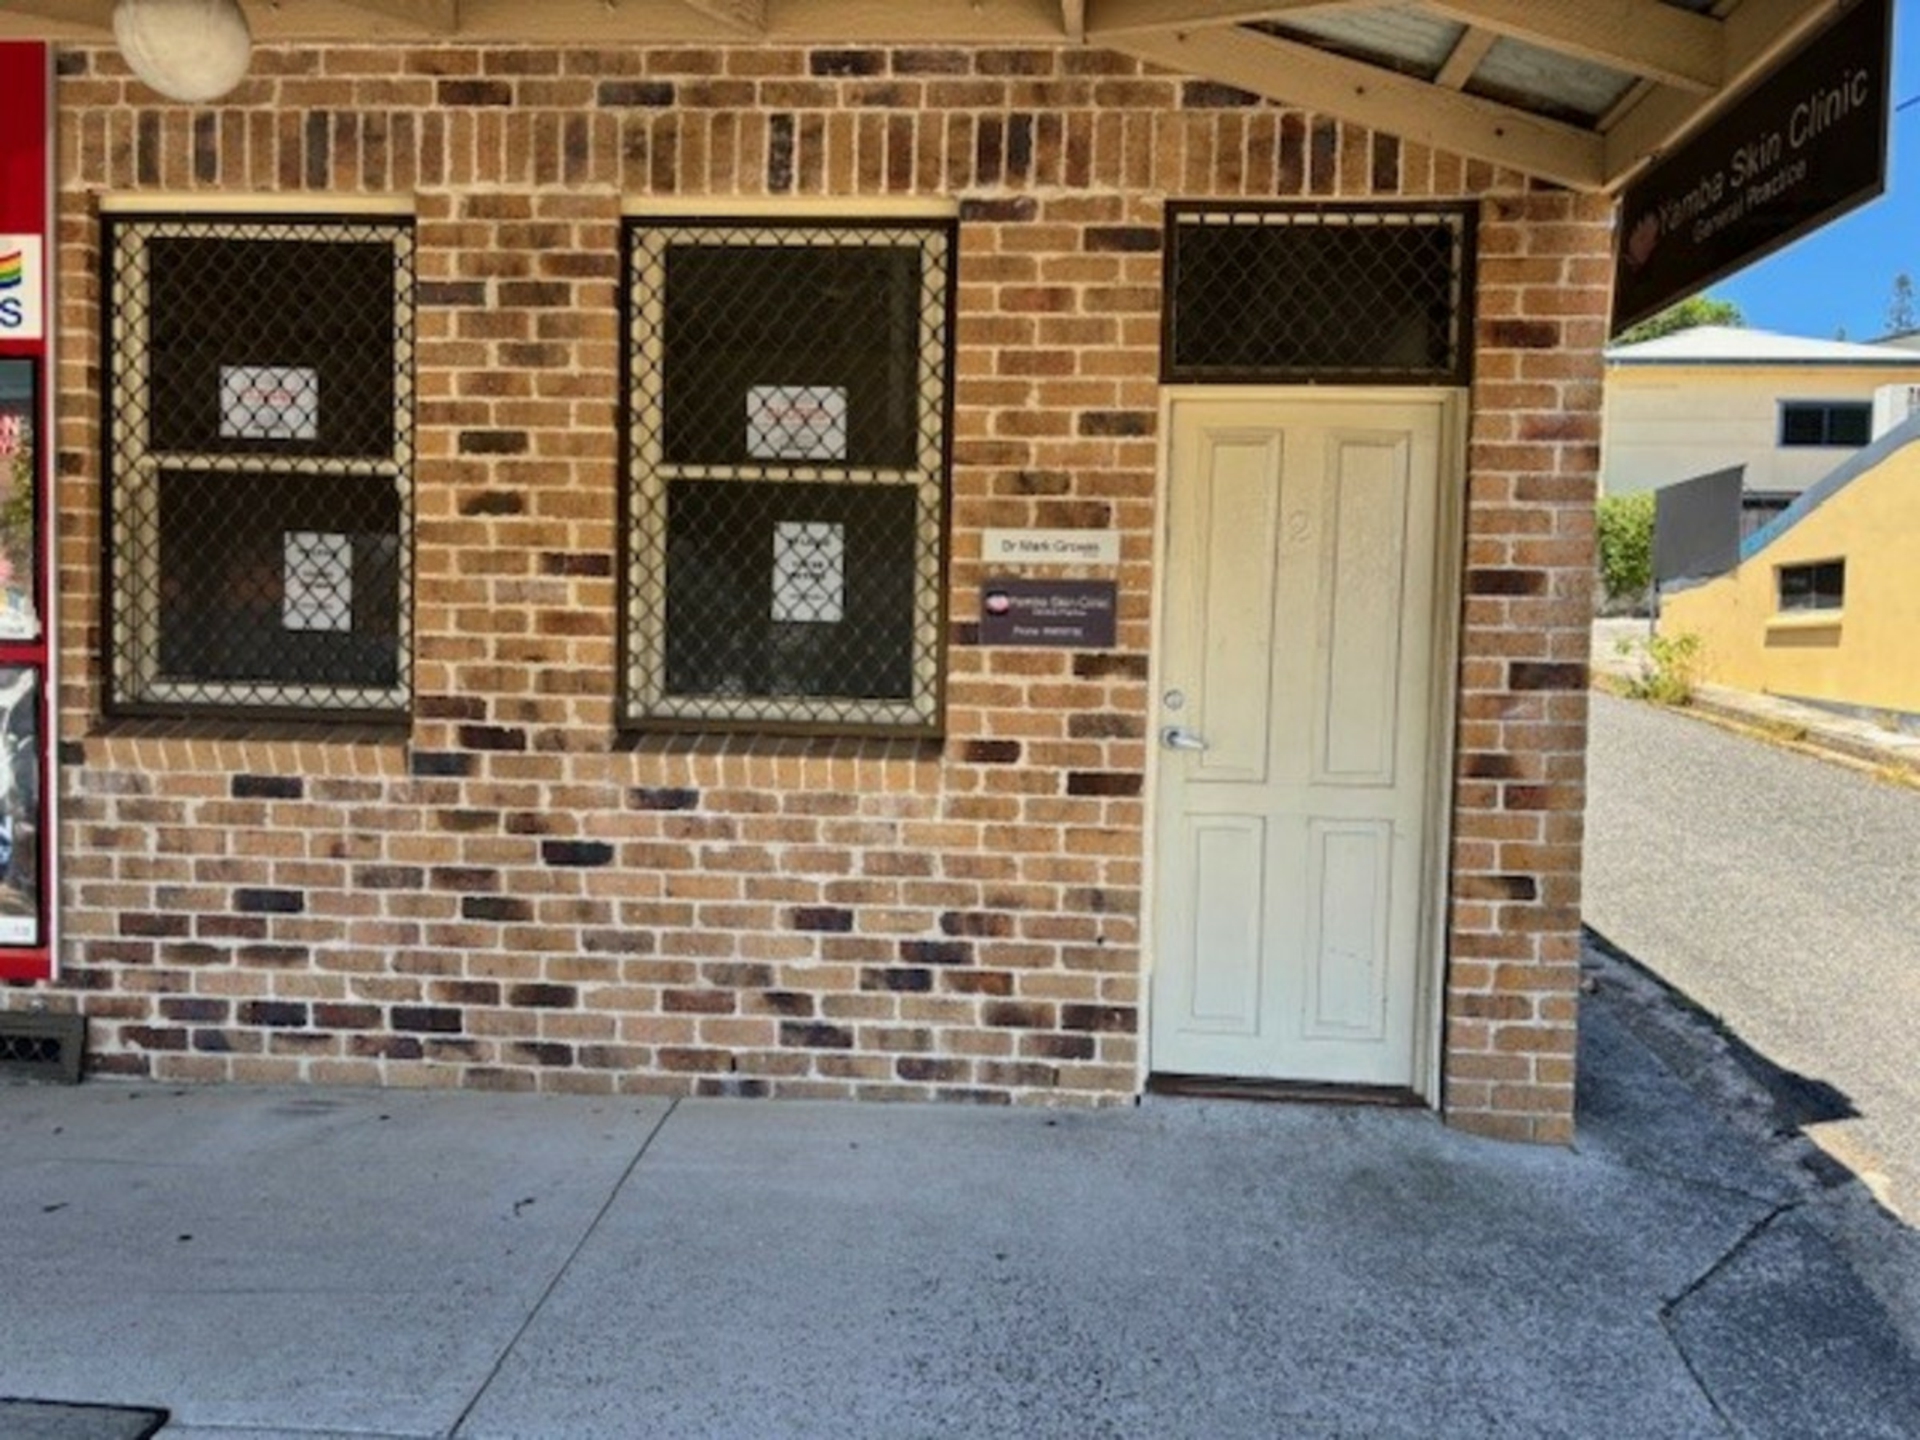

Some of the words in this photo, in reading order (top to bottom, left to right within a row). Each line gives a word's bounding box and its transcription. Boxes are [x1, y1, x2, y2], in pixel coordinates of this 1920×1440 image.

[1658, 171, 1725, 236] Yamba
[1730, 131, 1781, 187] Skin
[1789, 69, 1868, 148] Clinic
[1002, 539, 1017, 553] Dr
